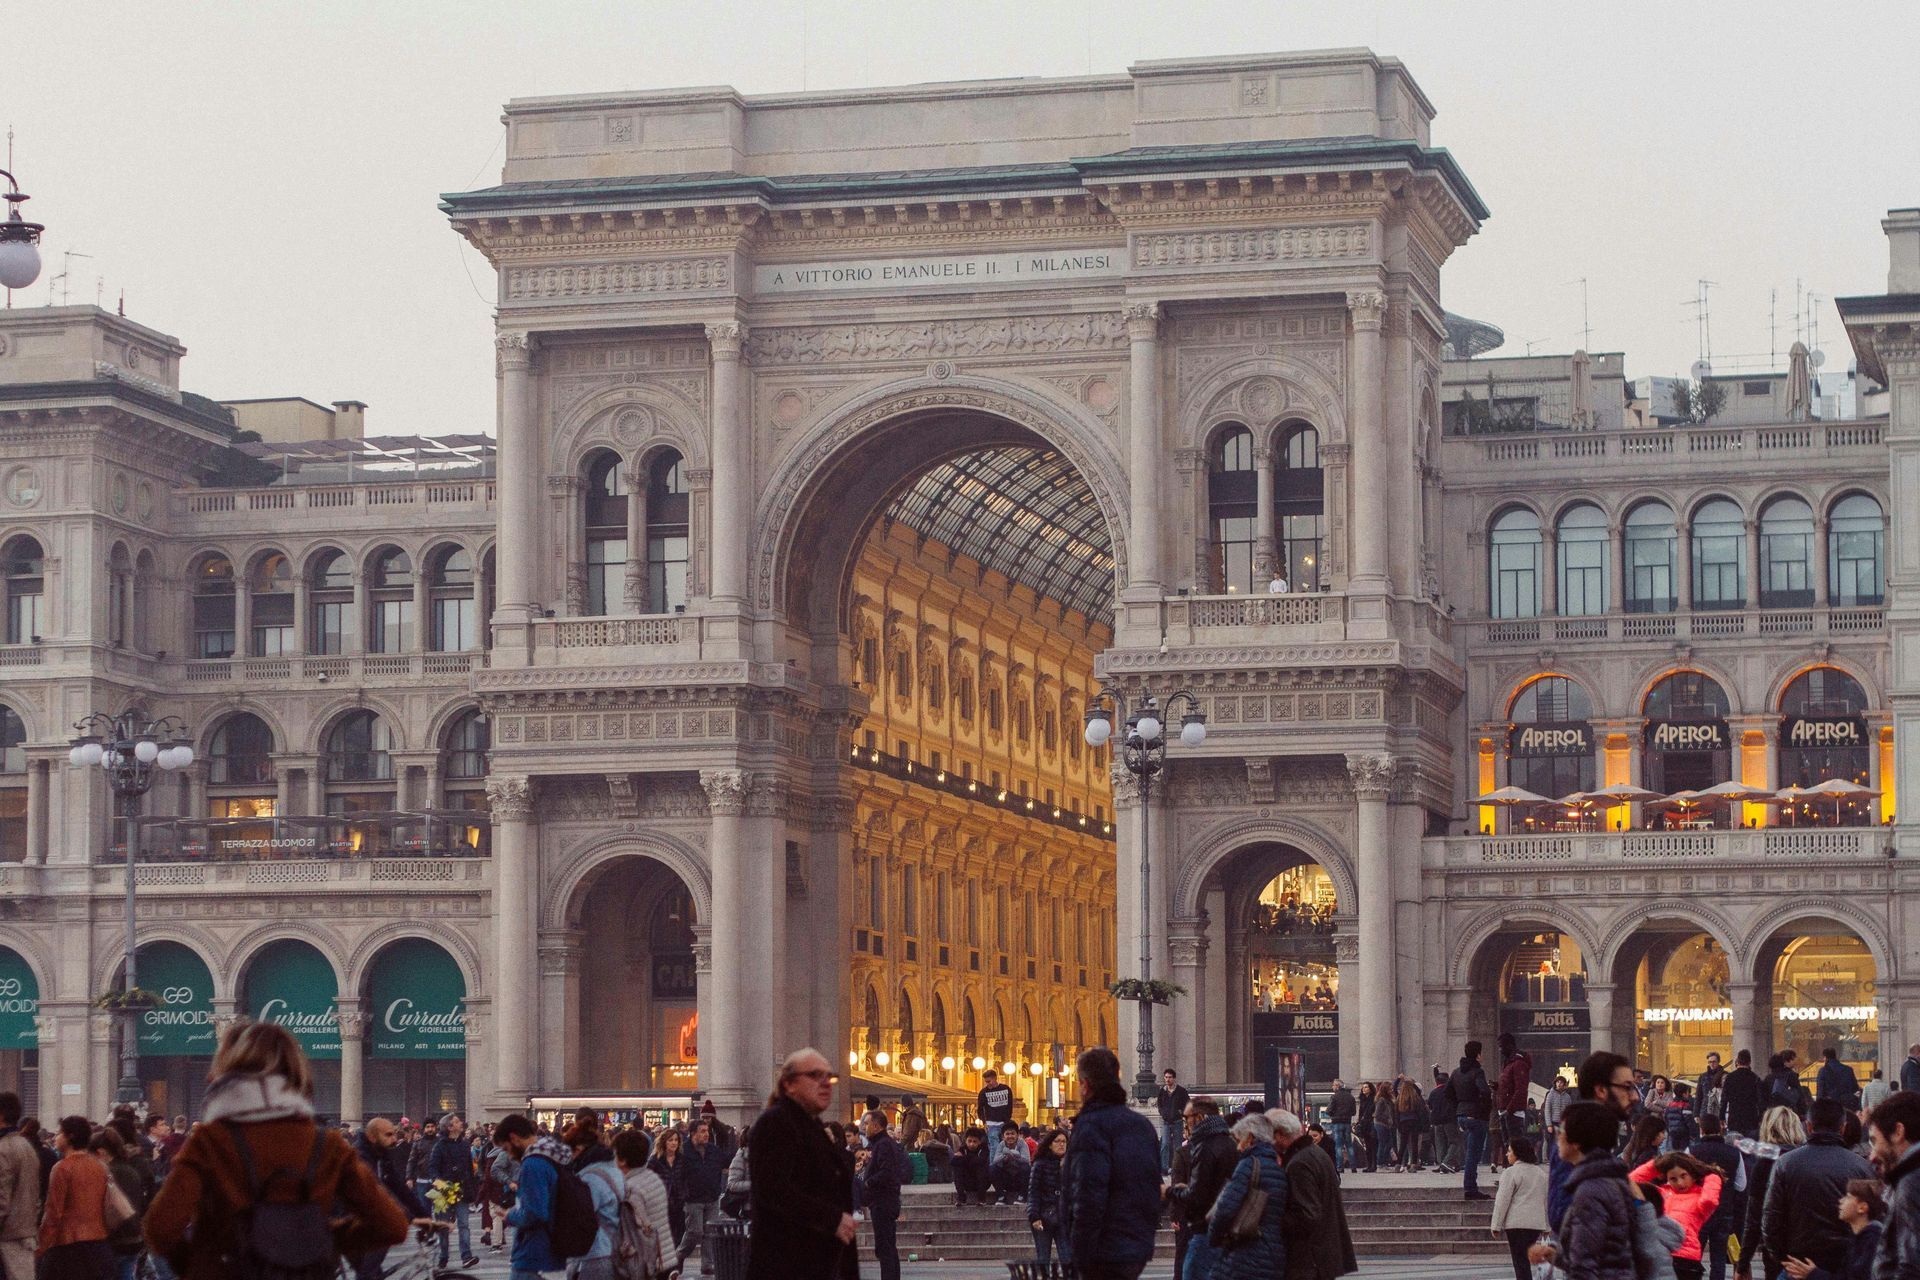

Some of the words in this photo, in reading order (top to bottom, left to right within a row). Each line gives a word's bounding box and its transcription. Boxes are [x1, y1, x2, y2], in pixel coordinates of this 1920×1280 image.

[774, 272, 784, 285] A
[795, 267, 872, 283] VITTORIO
[883, 263, 976, 280] EMANUELE
[1016, 260, 1020, 273] I
[1031, 255, 1109, 272] MILANESI
[221, 840, 270, 849] TERRAZZA
[271, 838, 306, 848] DUOMO
[307, 838, 316, 847] 21
[0, 999, 36, 1012] MOLDI
[1533, 1011, 1575, 1026] Motta
[1779, 1007, 1820, 1021] FOOD
[1821, 1006, 1877, 1020] MARKET
[1293, 1015, 1335, 1030] Motta
[292, 1026, 339, 1034] GIOIELLERIE
[418, 1026, 464, 1034] GIOIELLERIE
